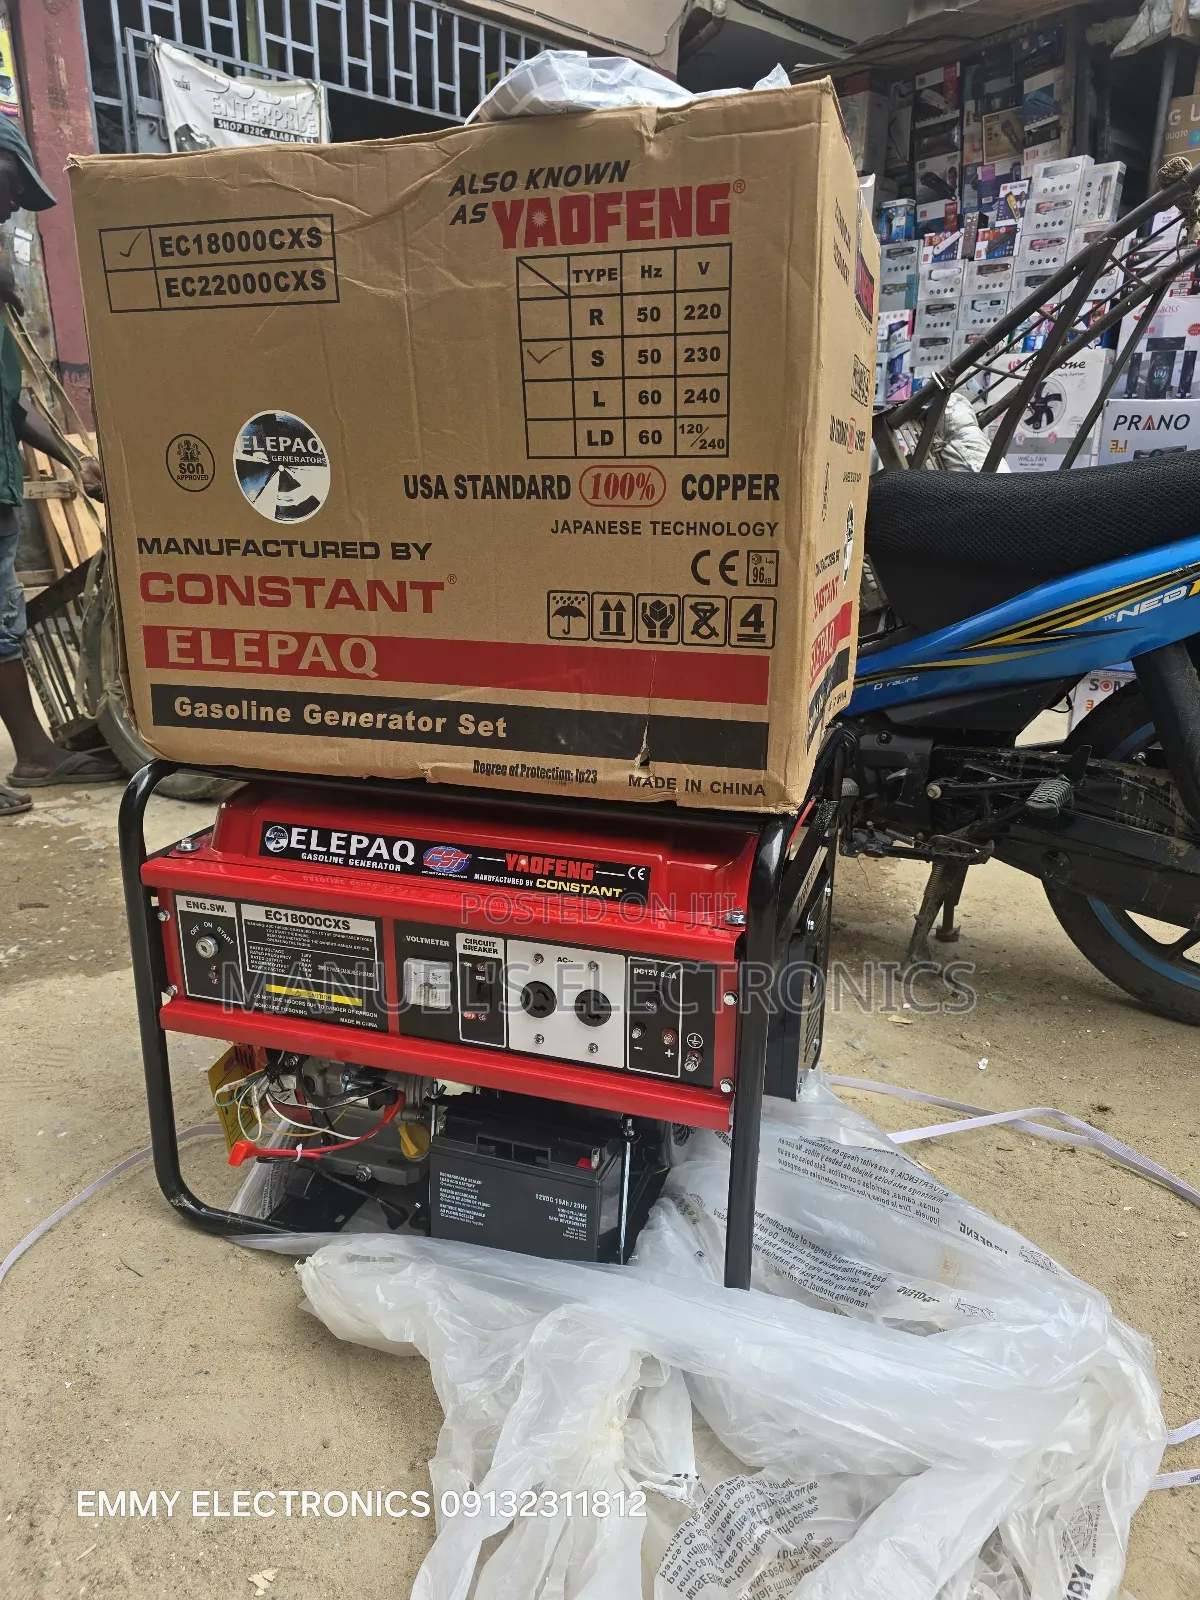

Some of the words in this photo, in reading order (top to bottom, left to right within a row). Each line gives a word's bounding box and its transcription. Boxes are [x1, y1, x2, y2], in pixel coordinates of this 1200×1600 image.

[212, 96, 318, 134] ENTERPRISE
[218, 119, 242, 132] SHOP
[269, 130, 295, 142] ALABA
[448, 170, 518, 198] ALSO
[524, 159, 631, 190] KNOWN
[450, 202, 489, 226] AS
[491, 182, 731, 250] YAOFENG
[159, 227, 323, 258] EC18000CXS
[164, 269, 327, 299] EC22000CXS
[572, 267, 618, 284] TYPE
[640, 264, 662, 279] Hz
[697, 261, 711, 276] V
[589, 308, 604, 327] R
[636, 306, 661, 323] 50
[683, 303, 722, 320] 220
[591, 350, 605, 367] S
[637, 348, 661, 365] 50
[683, 346, 721, 363] 230
[593, 390, 606, 407] L
[638, 389, 662, 405] 60
[683, 388, 720, 405] 240
[1113, 414, 1191, 431] PRANO
[240, 436, 324, 455] ELEPAQ
[586, 430, 614, 447] LD
[638, 429, 662, 446] 60
[271, 454, 328, 465] GENERATORS
[176, 473, 209, 482] APPROVED
[403, 474, 449, 501] USA
[454, 474, 571, 501] STANDARD
[588, 471, 657, 501] 100%
[681, 473, 780, 501] COPPER
[550, 519, 642, 536] JAPANESE
[650, 520, 779, 538] TECHNOLOGY
[137, 537, 380, 560] MANUFACTURED
[391, 542, 433, 561] BY
[691, 549, 739, 587] CE
[140, 571, 445, 614] CONSTANT
[1103, 612, 1116, 622] TVS
[1117, 585, 1188, 622] NEO
[166, 628, 379, 678] ELEPAQ
[174, 696, 291, 723] Gasoline
[303, 704, 447, 733] Generator
[458, 714, 507, 738] Set
[473, 759, 507, 777] Degree
[508, 763, 520, 777] of
[520, 763, 574, 783] Protection:
[628, 775, 677, 791] MADE
[685, 778, 701, 792] IN
[710, 781, 766, 797] CHINA
[289, 827, 415, 865] ELEPAQ
[301, 852, 344, 865] GASOLINE
[348, 858, 401, 872] GENERATOR
[424, 849, 470, 869] CST
[505, 853, 595, 881] YAOFENG
[628, 866, 646, 880] CE
[474, 873, 524, 886] MANUFACTURED
[525, 879, 534, 887] BY
[535, 878, 623, 898] CONSTANT
[186, 900, 227, 913] ENG.SW.
[264, 909, 351, 931] EC18000CXS
[190, 924, 200, 936] OFF
[203, 921, 213, 929] ON
[216, 926, 235, 945] START
[406, 935, 450, 947] VOLTMETER
[464, 938, 497, 948] CIRCUIT
[462, 944, 499, 955] BREAKER
[633, 967, 658, 977] DC12V
